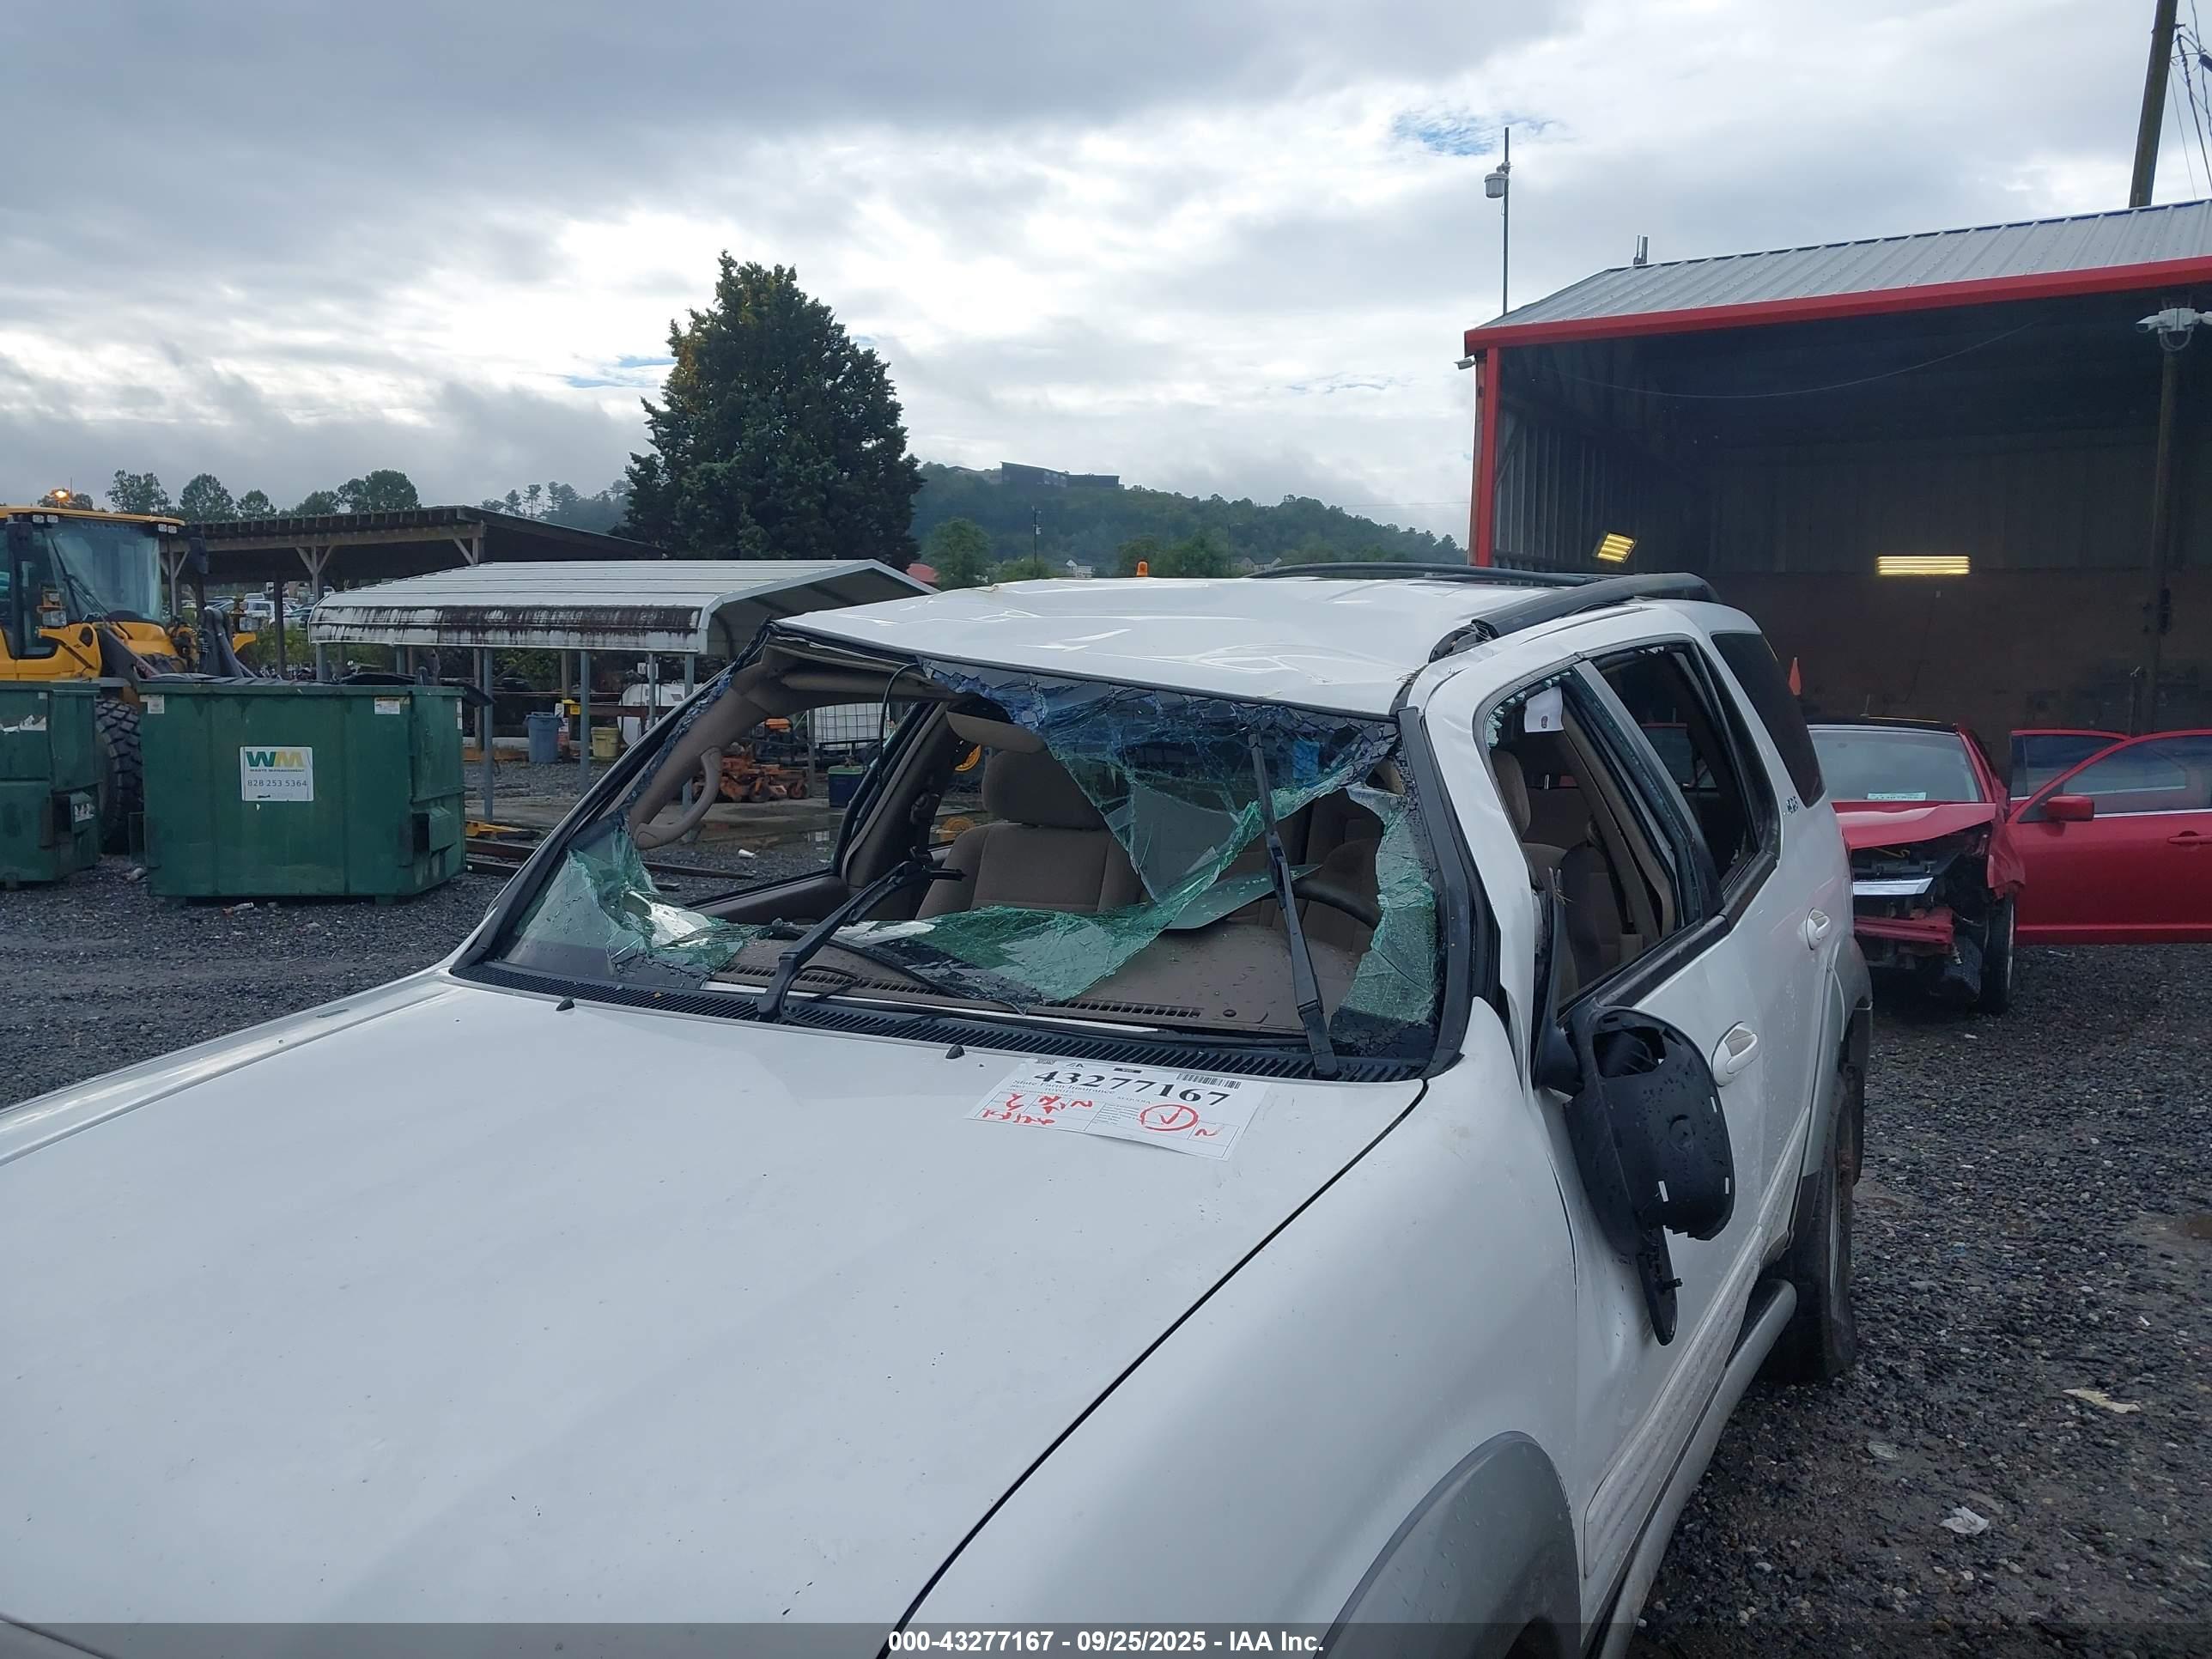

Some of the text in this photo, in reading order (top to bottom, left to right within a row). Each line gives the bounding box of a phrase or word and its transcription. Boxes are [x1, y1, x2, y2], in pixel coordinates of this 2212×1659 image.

[246, 750, 304, 768] WM
[247, 779, 307, 787] 828 253 5364
[1033, 1070, 1231, 1106] 43277167
